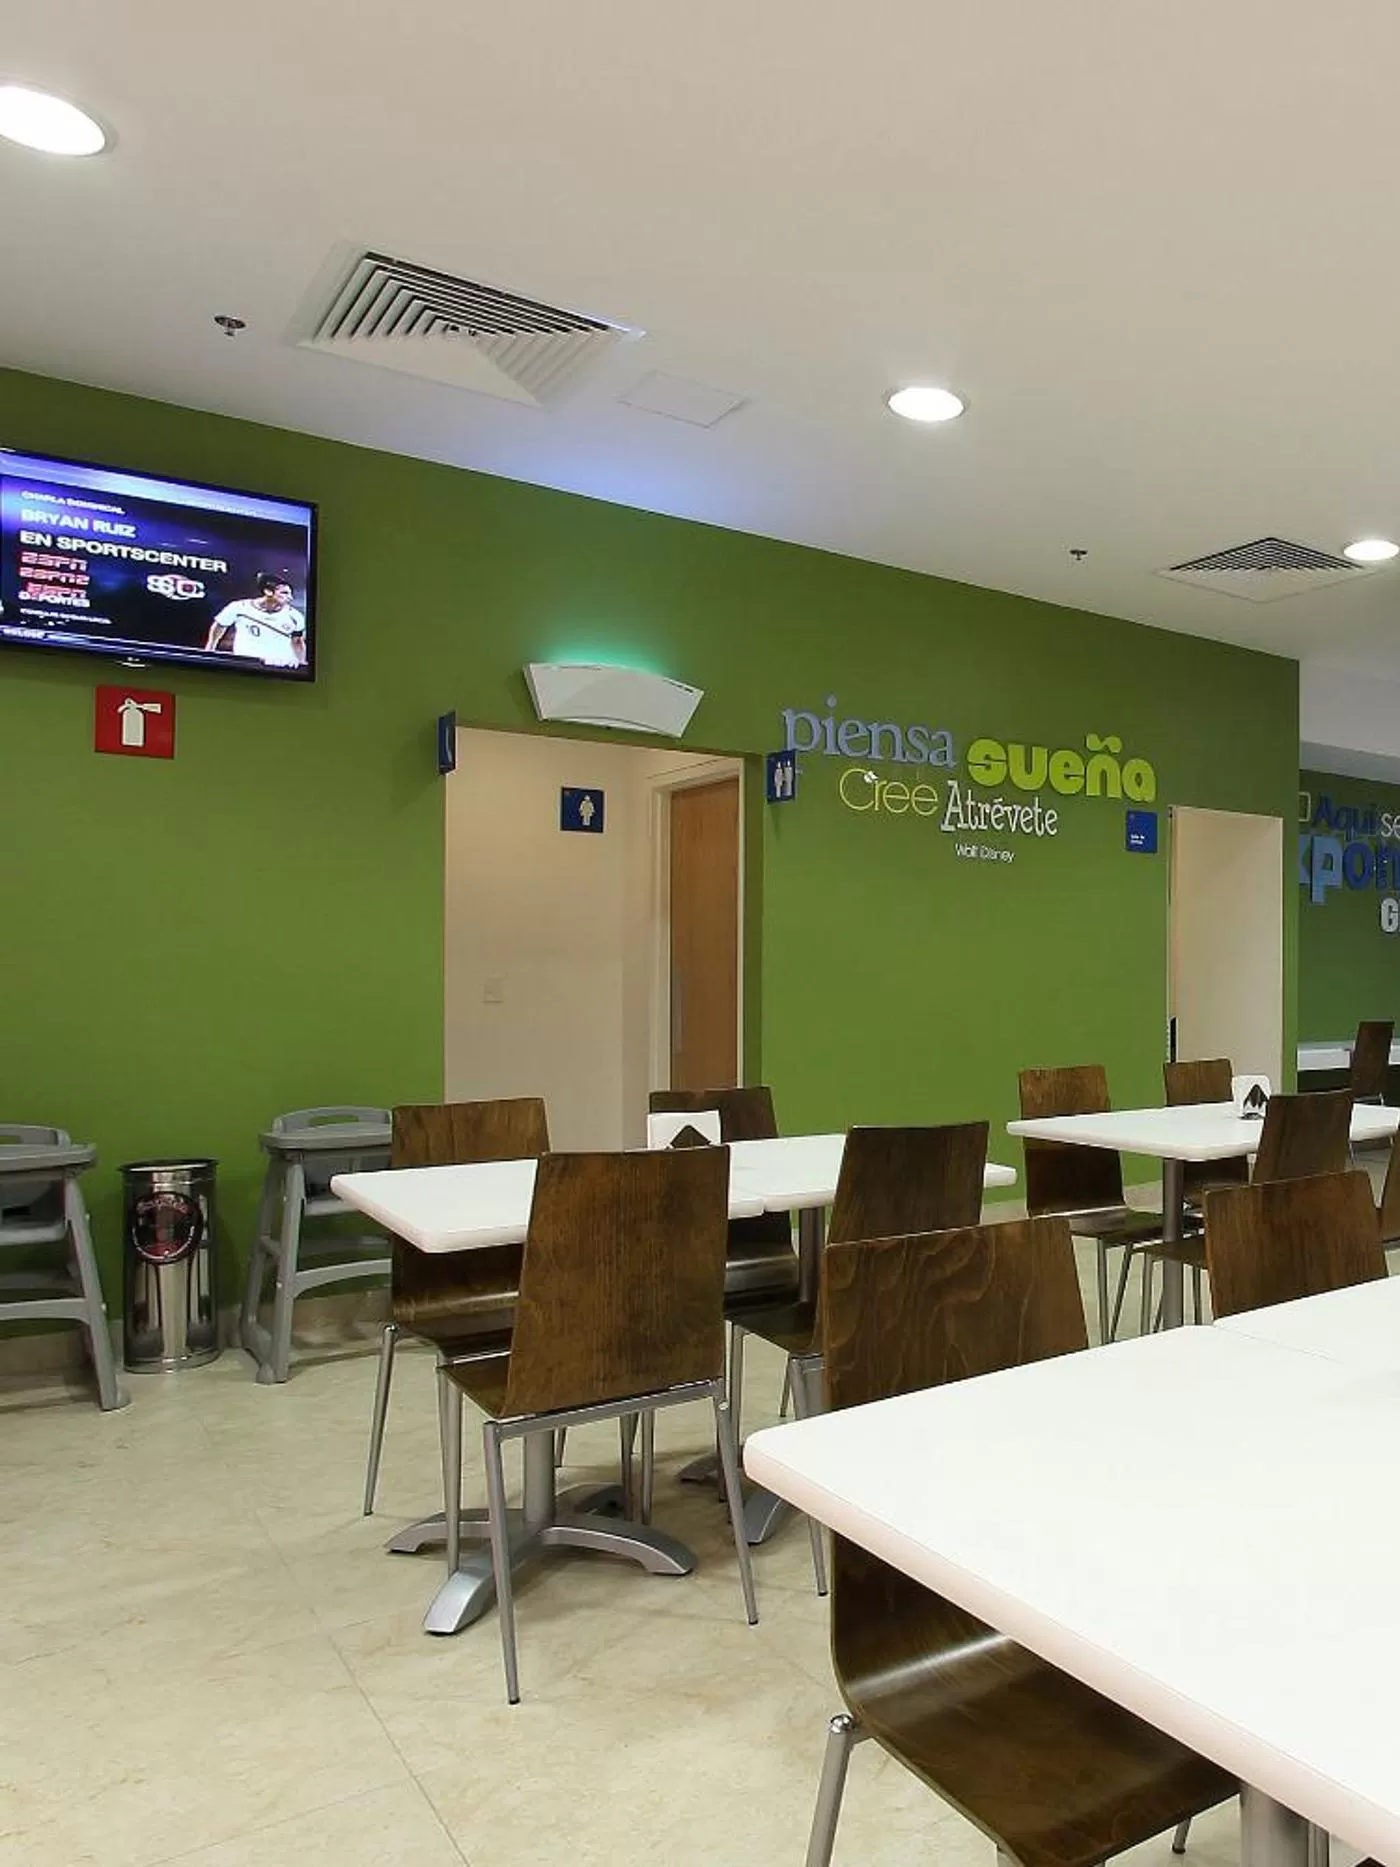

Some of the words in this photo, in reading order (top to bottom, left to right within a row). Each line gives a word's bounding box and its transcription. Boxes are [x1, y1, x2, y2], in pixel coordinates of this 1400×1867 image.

[21, 508, 89, 530] BRYAN
[92, 519, 137, 539] RUIZ
[20, 530, 53, 548] EN
[56, 536, 228, 573] SPORTSCENTER
[781, 694, 957, 768] piensa
[967, 732, 1157, 804] sueña
[839, 767, 939, 816] Cree
[940, 780, 1058, 837] Atrévete
